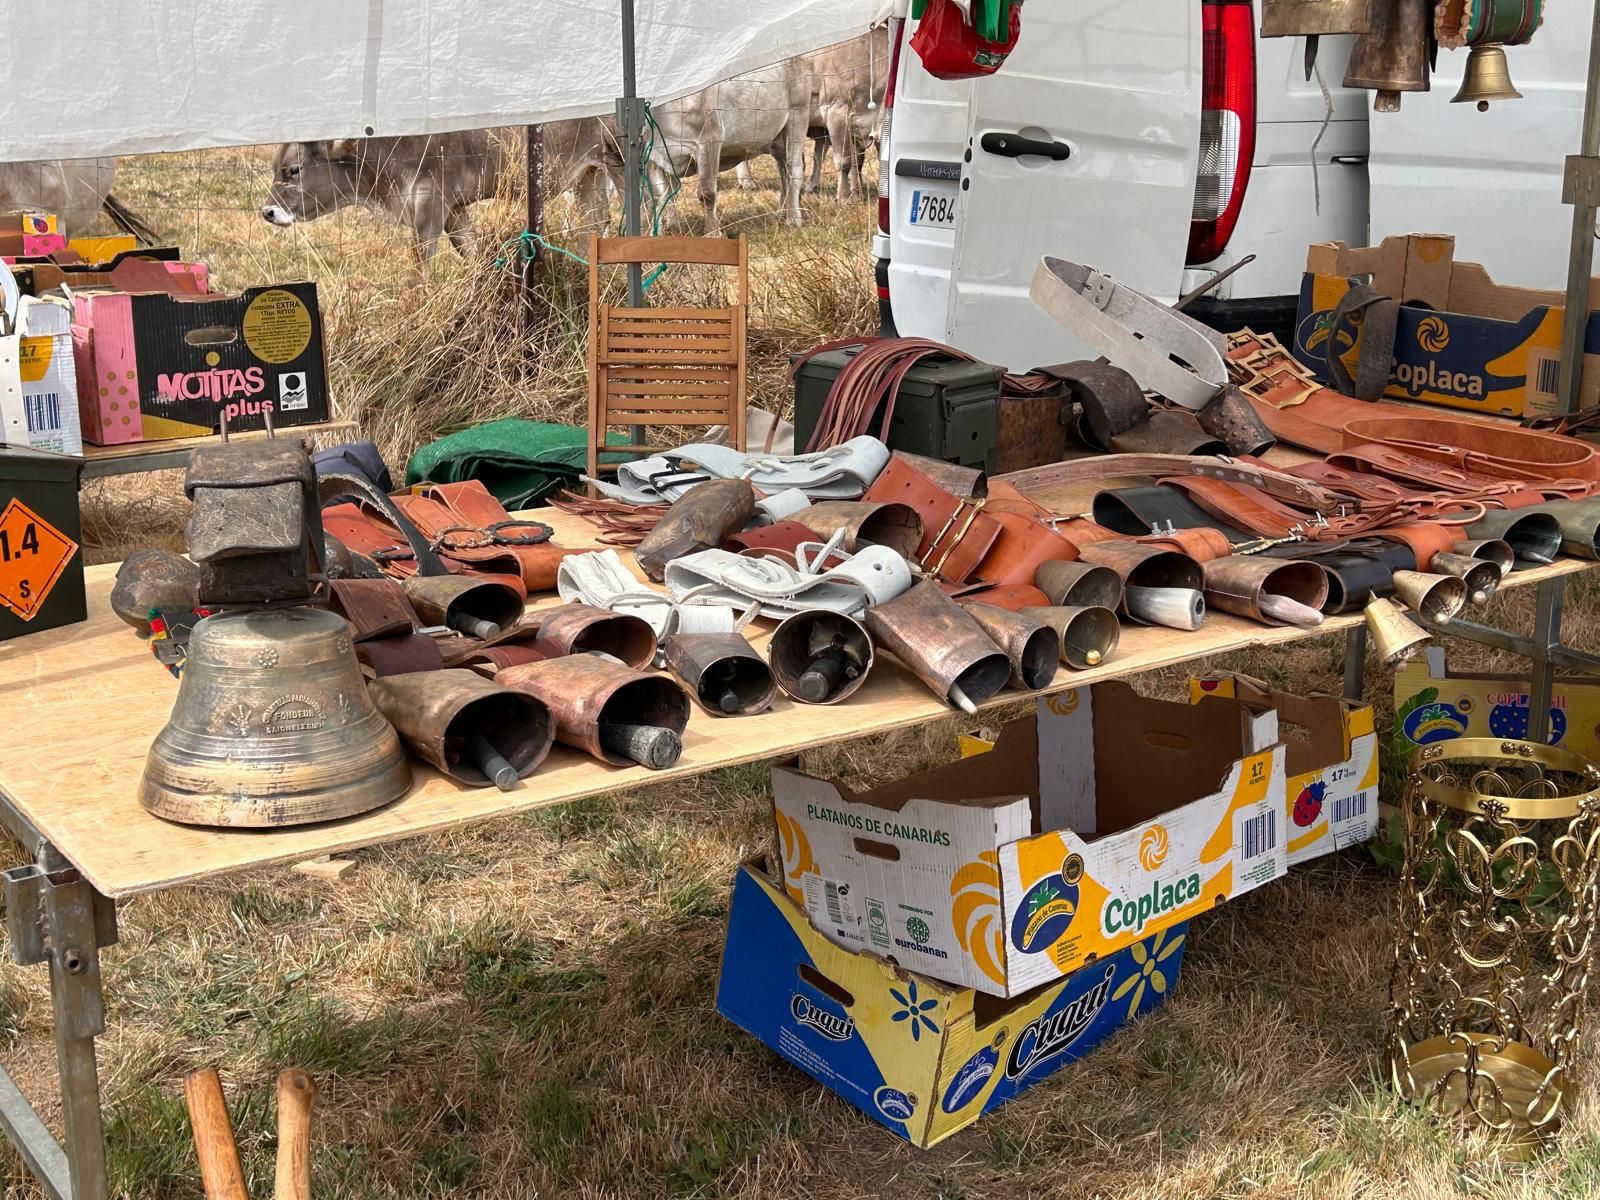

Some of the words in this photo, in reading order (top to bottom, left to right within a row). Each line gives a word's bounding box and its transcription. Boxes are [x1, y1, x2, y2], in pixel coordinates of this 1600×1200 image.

[919, 195, 955, 224] 7684
[276, 301, 300, 310] EXTRA
[19, 344, 37, 357] 17
[157, 366, 265, 402] MOTITAS
[225, 398, 274, 422] plus
[0, 522, 39, 563] 1.4
[18, 579, 31, 599] S
[275, 708, 316, 721] FONDEUR
[1250, 761, 1264, 778] 17
[1331, 769, 1344, 783] 17
[807, 803, 863, 830] PLATANOS
[865, 818, 882, 834] DE
[884, 822, 951, 847] CANARIAS
[1104, 872, 1201, 934] Coplaca
[894, 937, 948, 960] eurobanan
[790, 993, 856, 1042] Cuqui
[1005, 963, 1116, 1084] Cuqui
